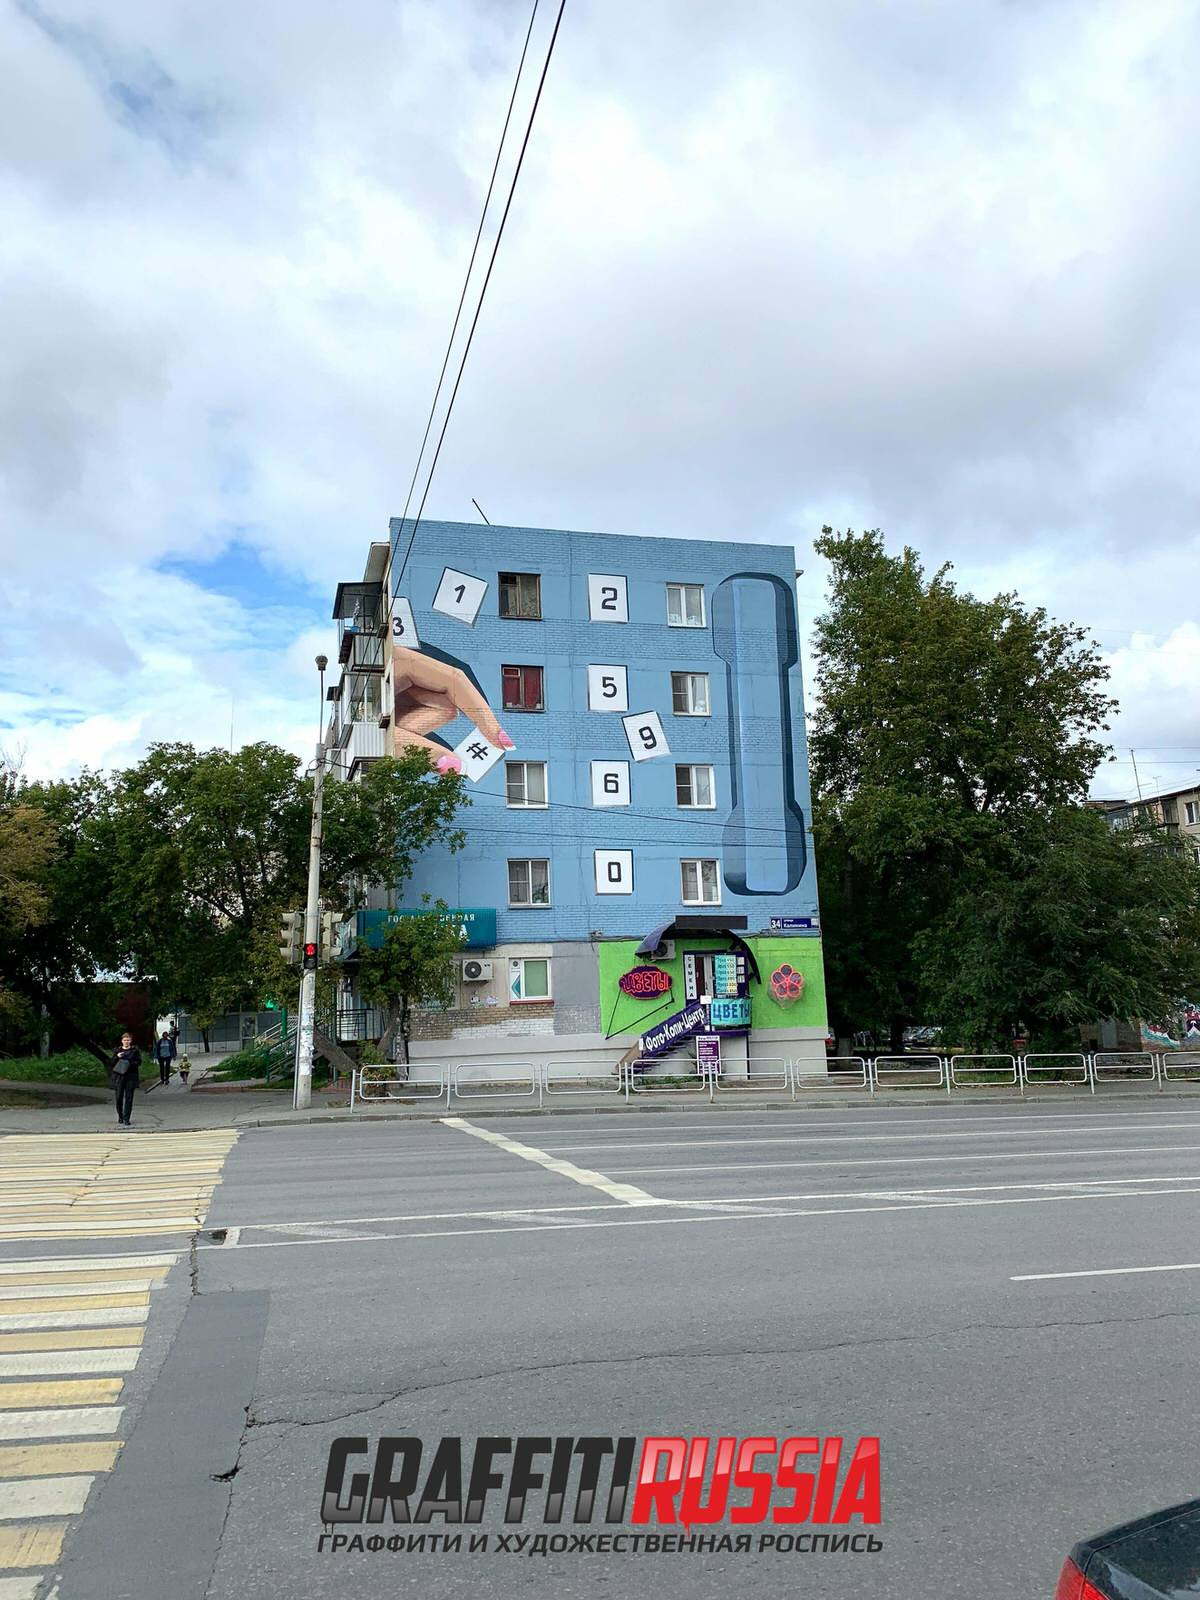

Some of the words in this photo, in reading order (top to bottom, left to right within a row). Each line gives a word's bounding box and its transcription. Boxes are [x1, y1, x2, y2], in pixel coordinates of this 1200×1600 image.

[454, 584, 466, 603] 1
[601, 587, 618, 611] 2
[392, 617, 405, 637] 3
[601, 676, 618, 698] 5
[638, 725, 658, 751] 9
[466, 742, 489, 761] #
[603, 773, 619, 794] 6
[607, 861, 622, 883] 0
[771, 919, 781, 929] 34
[621, 971, 669, 994] ЦВЕТЫ
[687, 956, 695, 998] СЕМЕНА
[713, 1003, 751, 1021] ЦВЕТЫ
